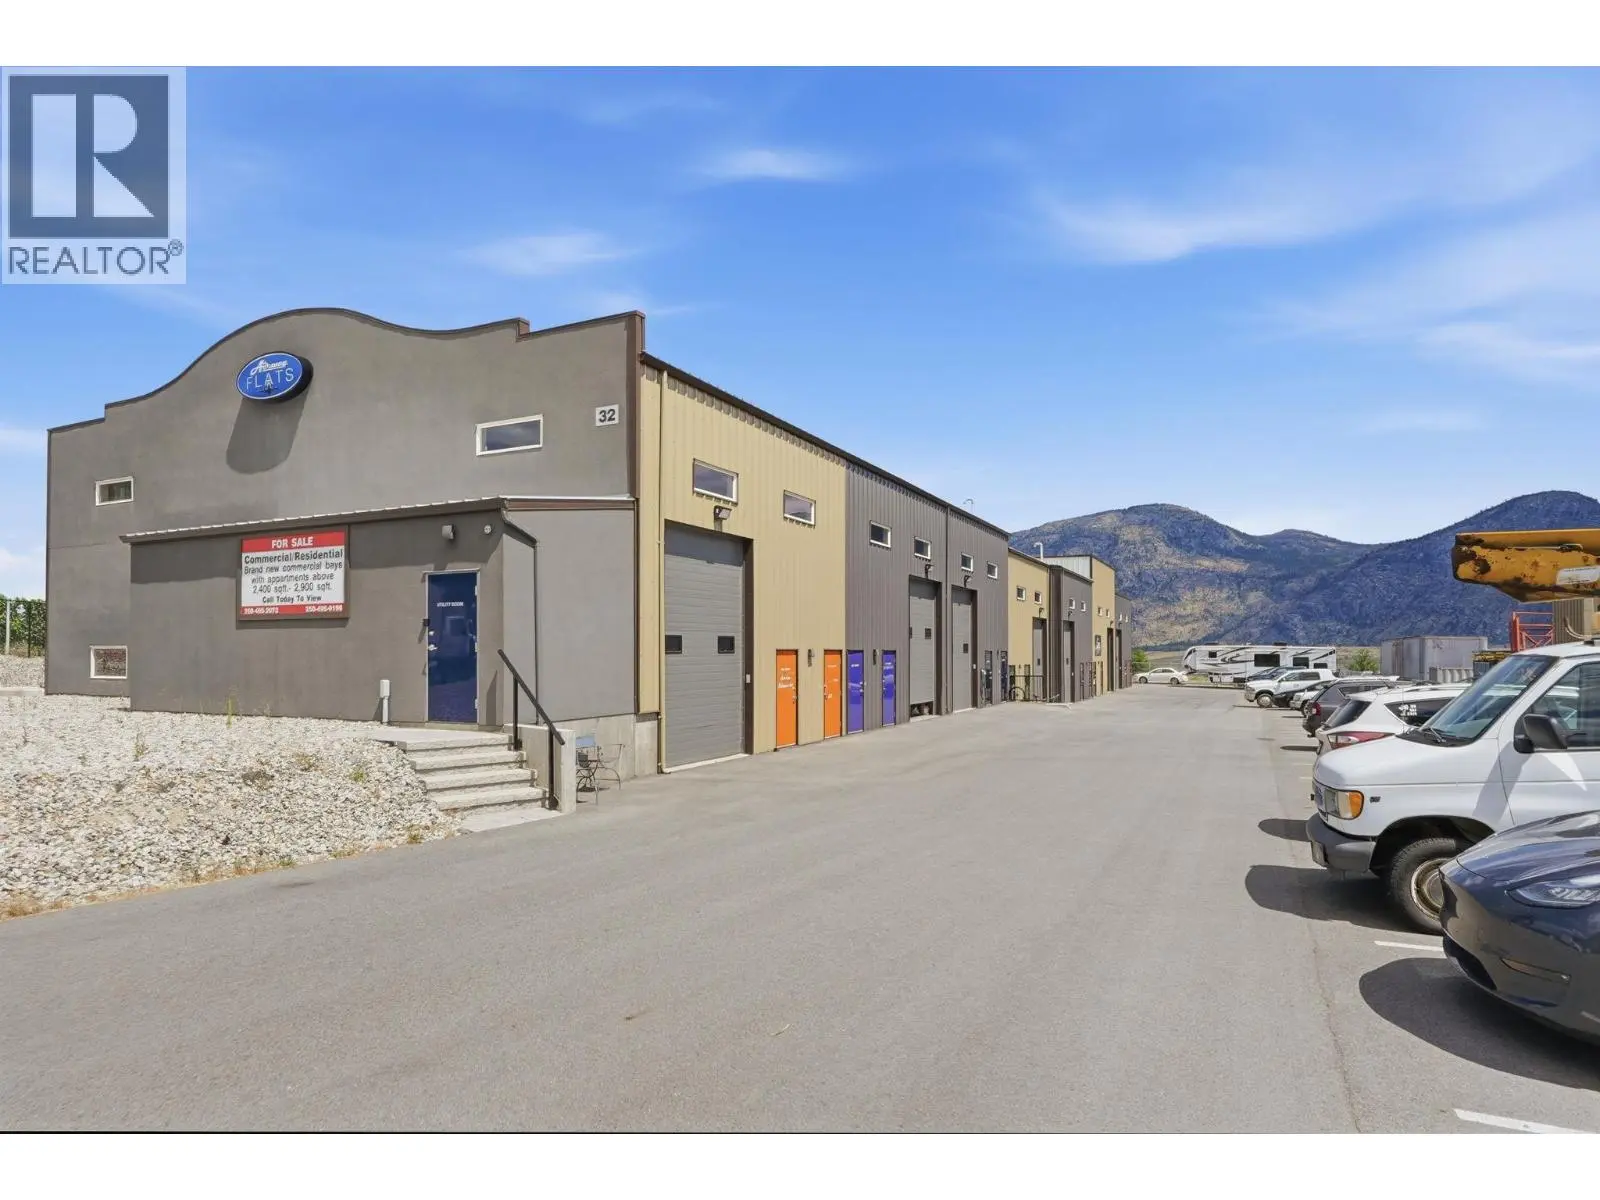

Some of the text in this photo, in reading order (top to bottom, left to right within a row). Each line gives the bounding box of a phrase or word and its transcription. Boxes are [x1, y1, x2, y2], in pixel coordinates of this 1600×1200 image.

[246, 368, 294, 390] FLATS
[599, 409, 615, 423] 32
[271, 536, 314, 549] FOR SALE
[244, 566, 263, 575] Brand
[282, 562, 322, 572] commercial
[325, 561, 343, 571] bays
[251, 576, 265, 584] with
[312, 572, 334, 581] above
[252, 585, 272, 595] 2,400
[294, 582, 314, 593] 2,900
[262, 596, 275, 604] Call
[276, 595, 294, 604] Today
[306, 594, 322, 602] View
